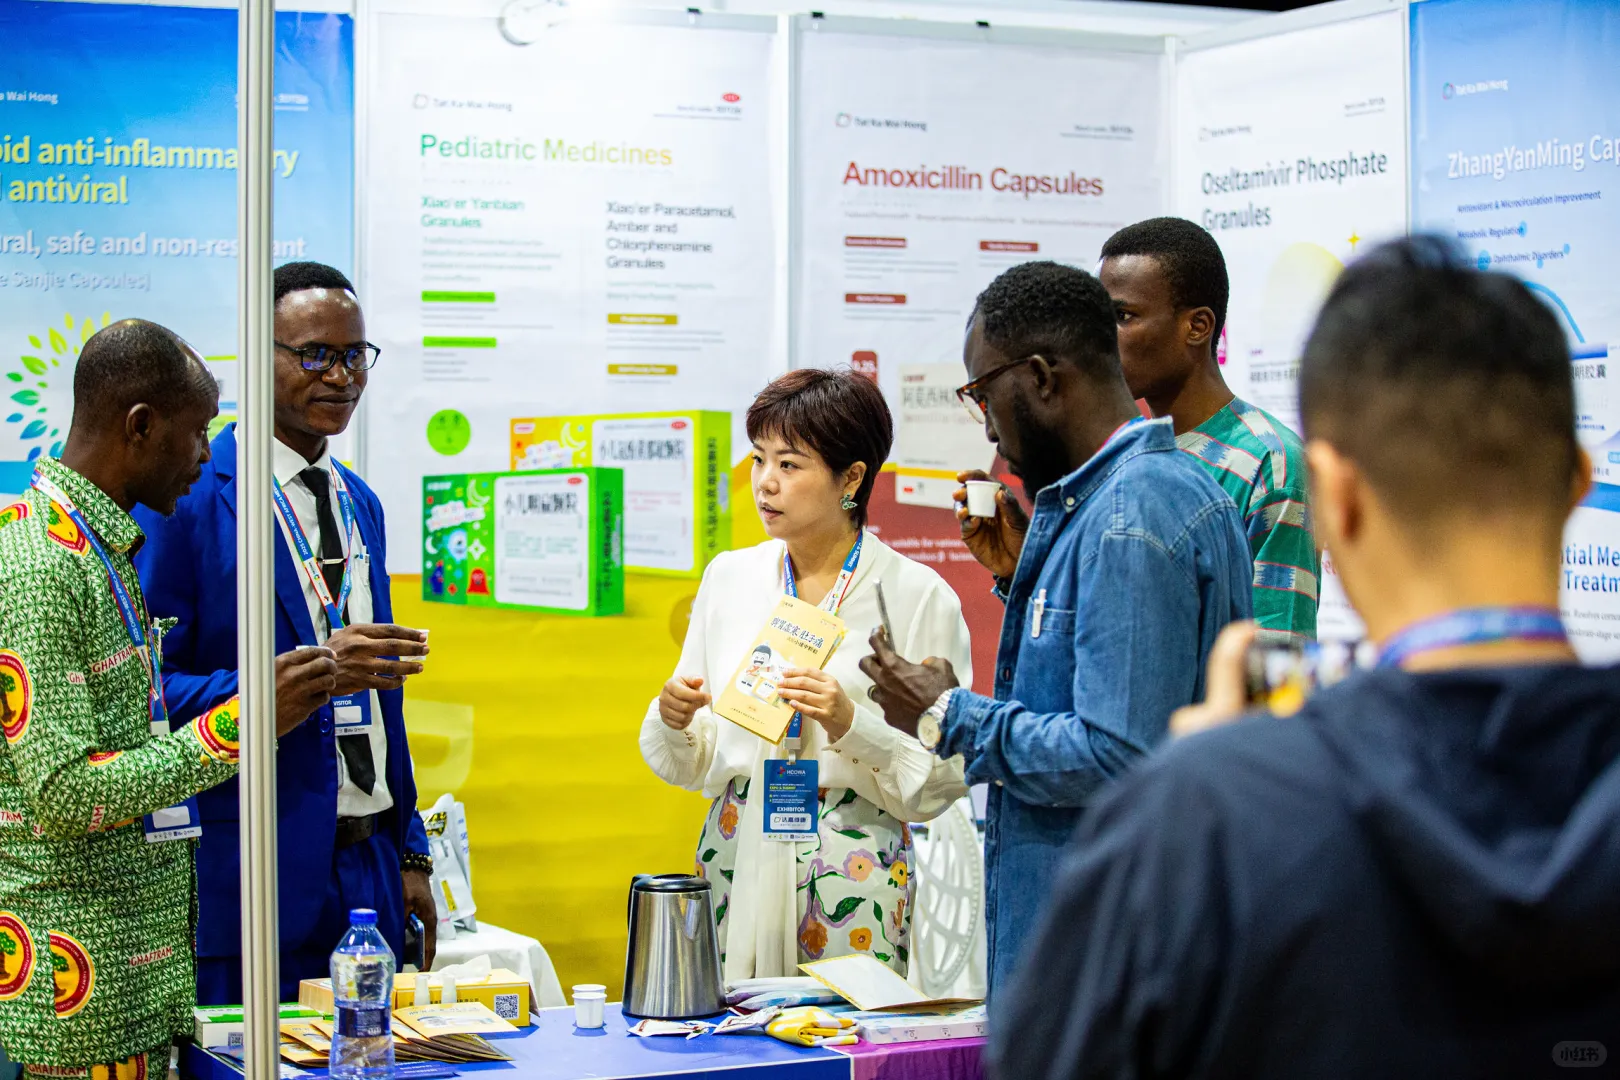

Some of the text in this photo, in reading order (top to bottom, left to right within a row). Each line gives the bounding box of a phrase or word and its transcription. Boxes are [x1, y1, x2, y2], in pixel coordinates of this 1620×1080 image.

[7, 92, 26, 101] Wai
[29, 92, 58, 104] Hong
[421, 133, 673, 166] Pediatric Medicines
[1448, 138, 1585, 181] ZhangYanMing
[843, 161, 1104, 199] Amoxicillin Capsules
[1201, 151, 1387, 195] Oseltamivir Phosphate
[9, 175, 128, 204] antiviral
[421, 214, 482, 228] Granules
[654, 222, 678, 234] and
[1203, 201, 1271, 231] Granules
[46, 230, 97, 254] safe
[100, 232, 147, 255] and
[606, 255, 666, 270] Granules
